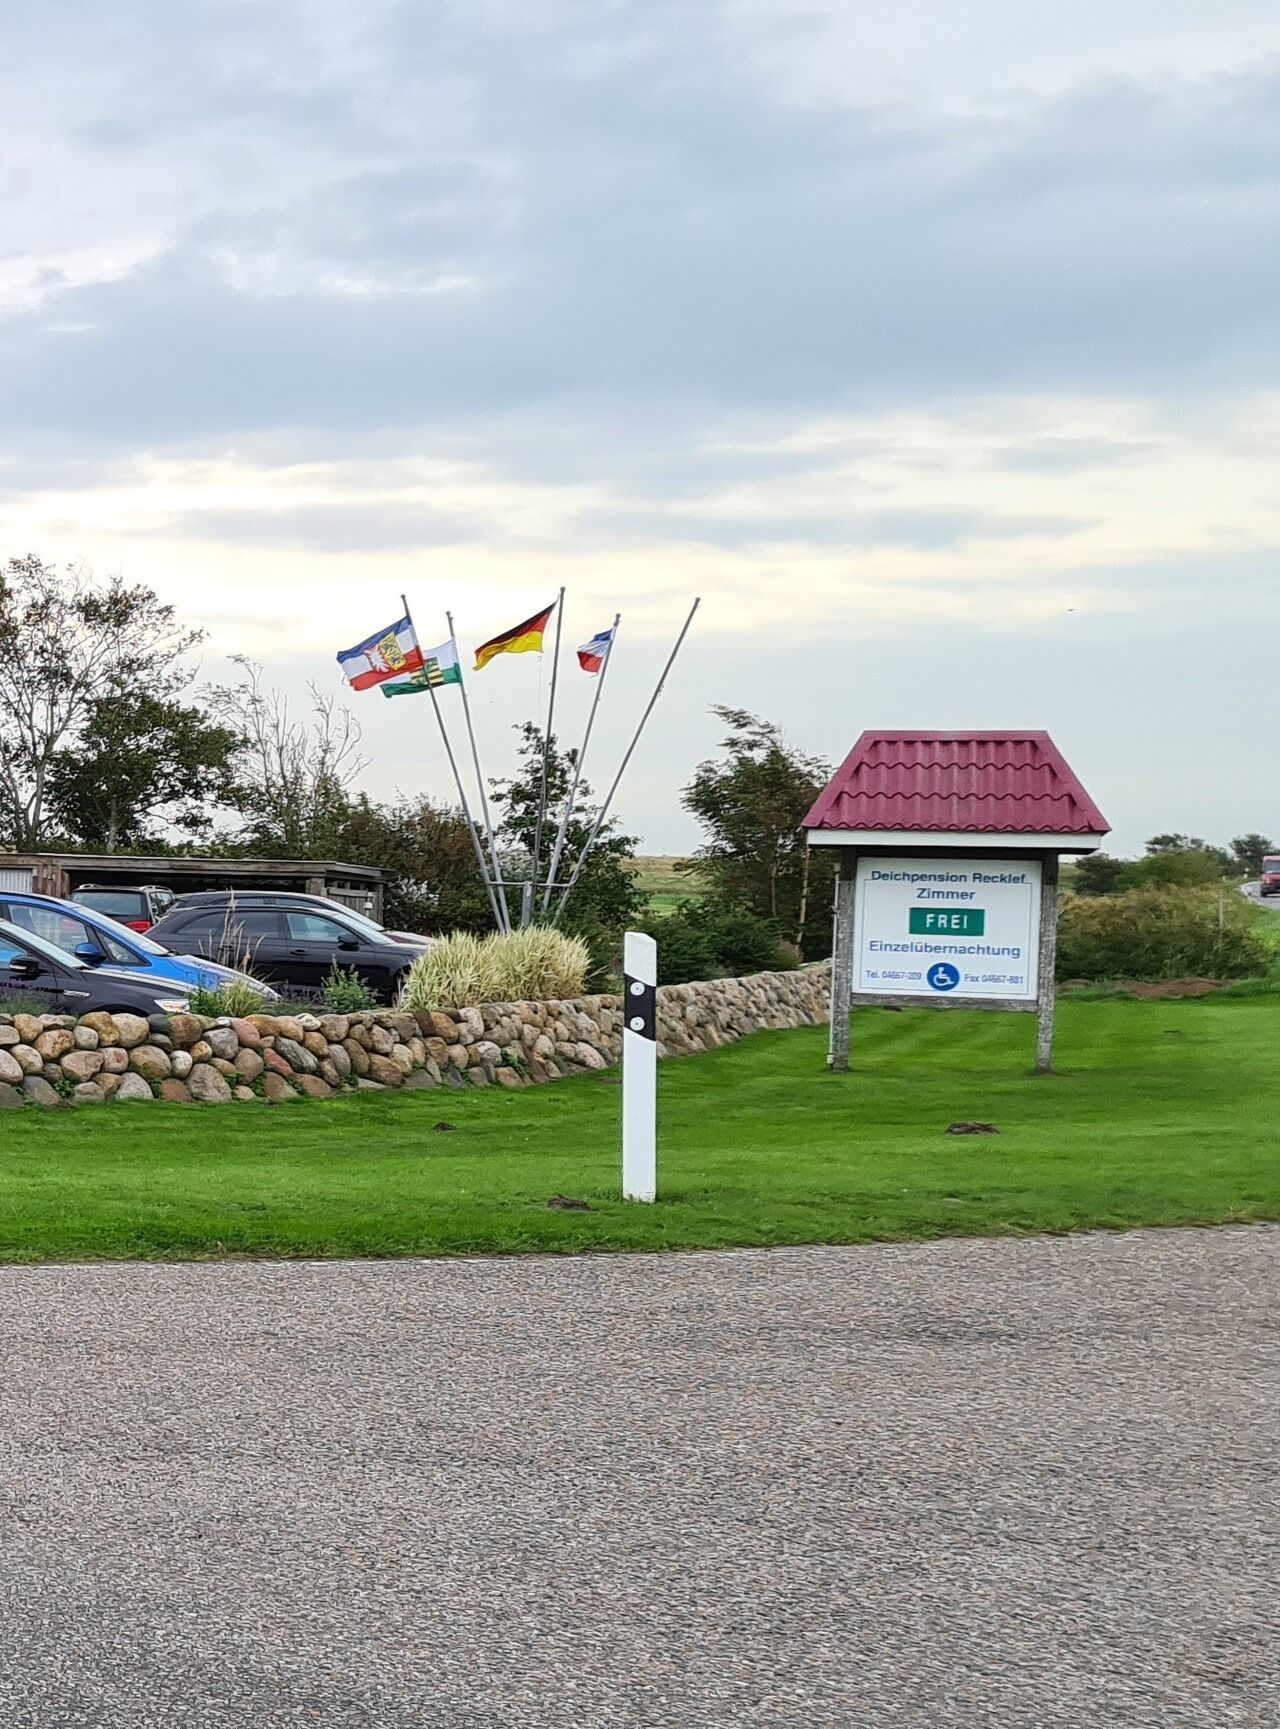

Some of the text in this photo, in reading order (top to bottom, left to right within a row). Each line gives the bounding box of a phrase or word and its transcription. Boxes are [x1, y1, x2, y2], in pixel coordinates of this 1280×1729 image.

[871, 870, 1026, 884] Deichpension Recklef
[916, 887, 976, 900] Zimmer
[925, 913, 969, 929] FREI
[869, 940, 1021, 959] Einzelübernachtung
[865, 969, 880, 979] Tel.
[964, 973, 980, 982] Fax
